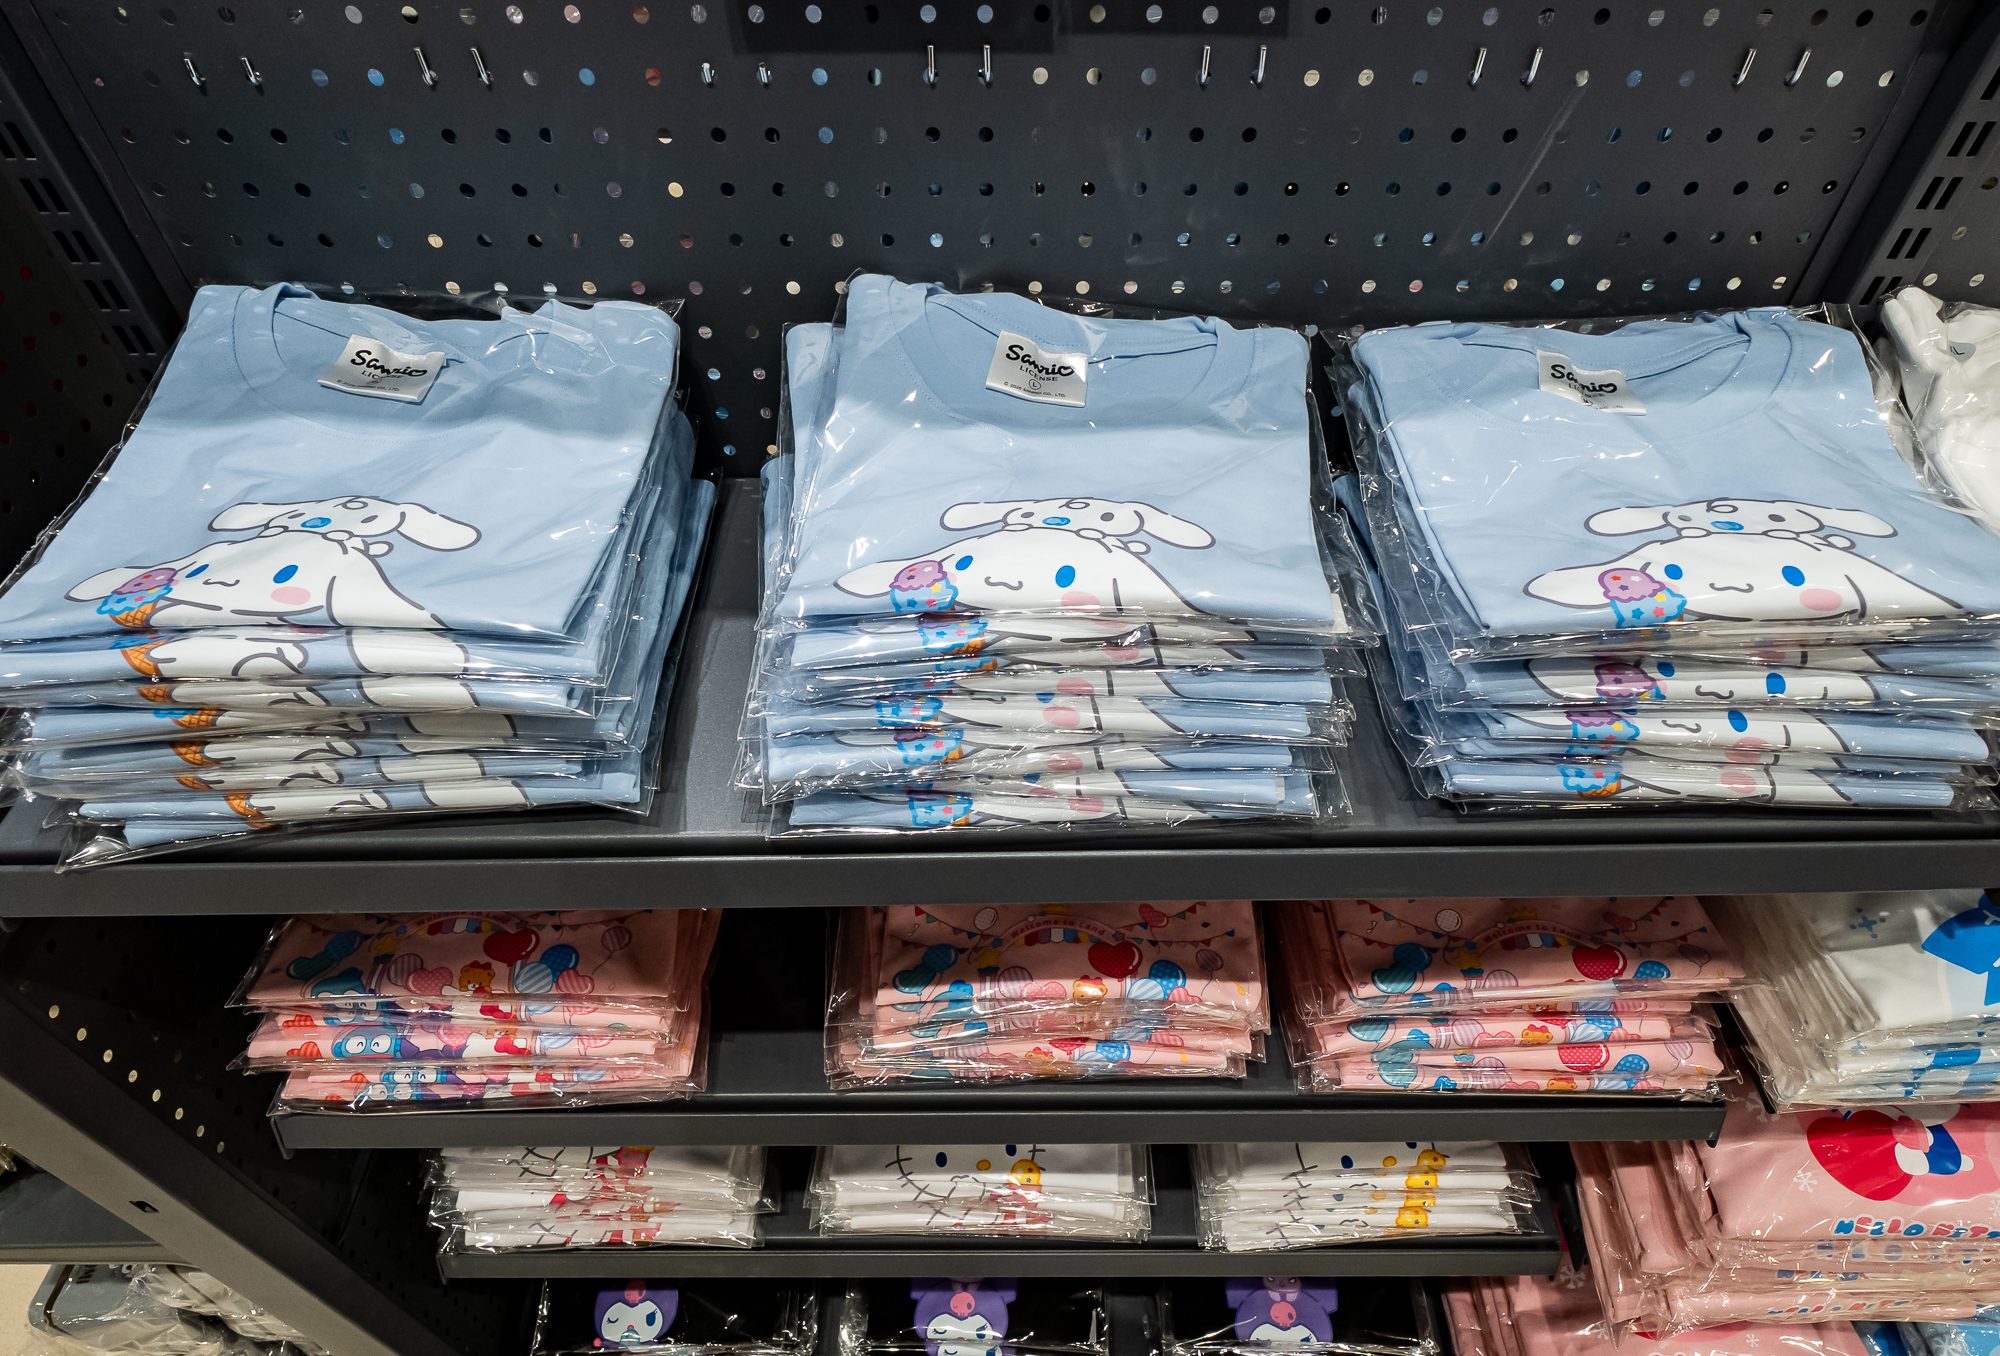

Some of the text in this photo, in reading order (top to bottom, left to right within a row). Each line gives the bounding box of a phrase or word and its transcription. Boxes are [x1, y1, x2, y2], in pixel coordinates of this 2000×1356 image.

[350, 350, 427, 377] Sanrio
[1005, 344, 1075, 377] Sanrio
[1019, 365, 1059, 382] LICENSE
[1010, 919, 1059, 939] Welcome
[1078, 921, 1106, 937] Land
[1482, 923, 1582, 943] Welcome to Land
[1833, 1216, 1925, 1236] HELLO
